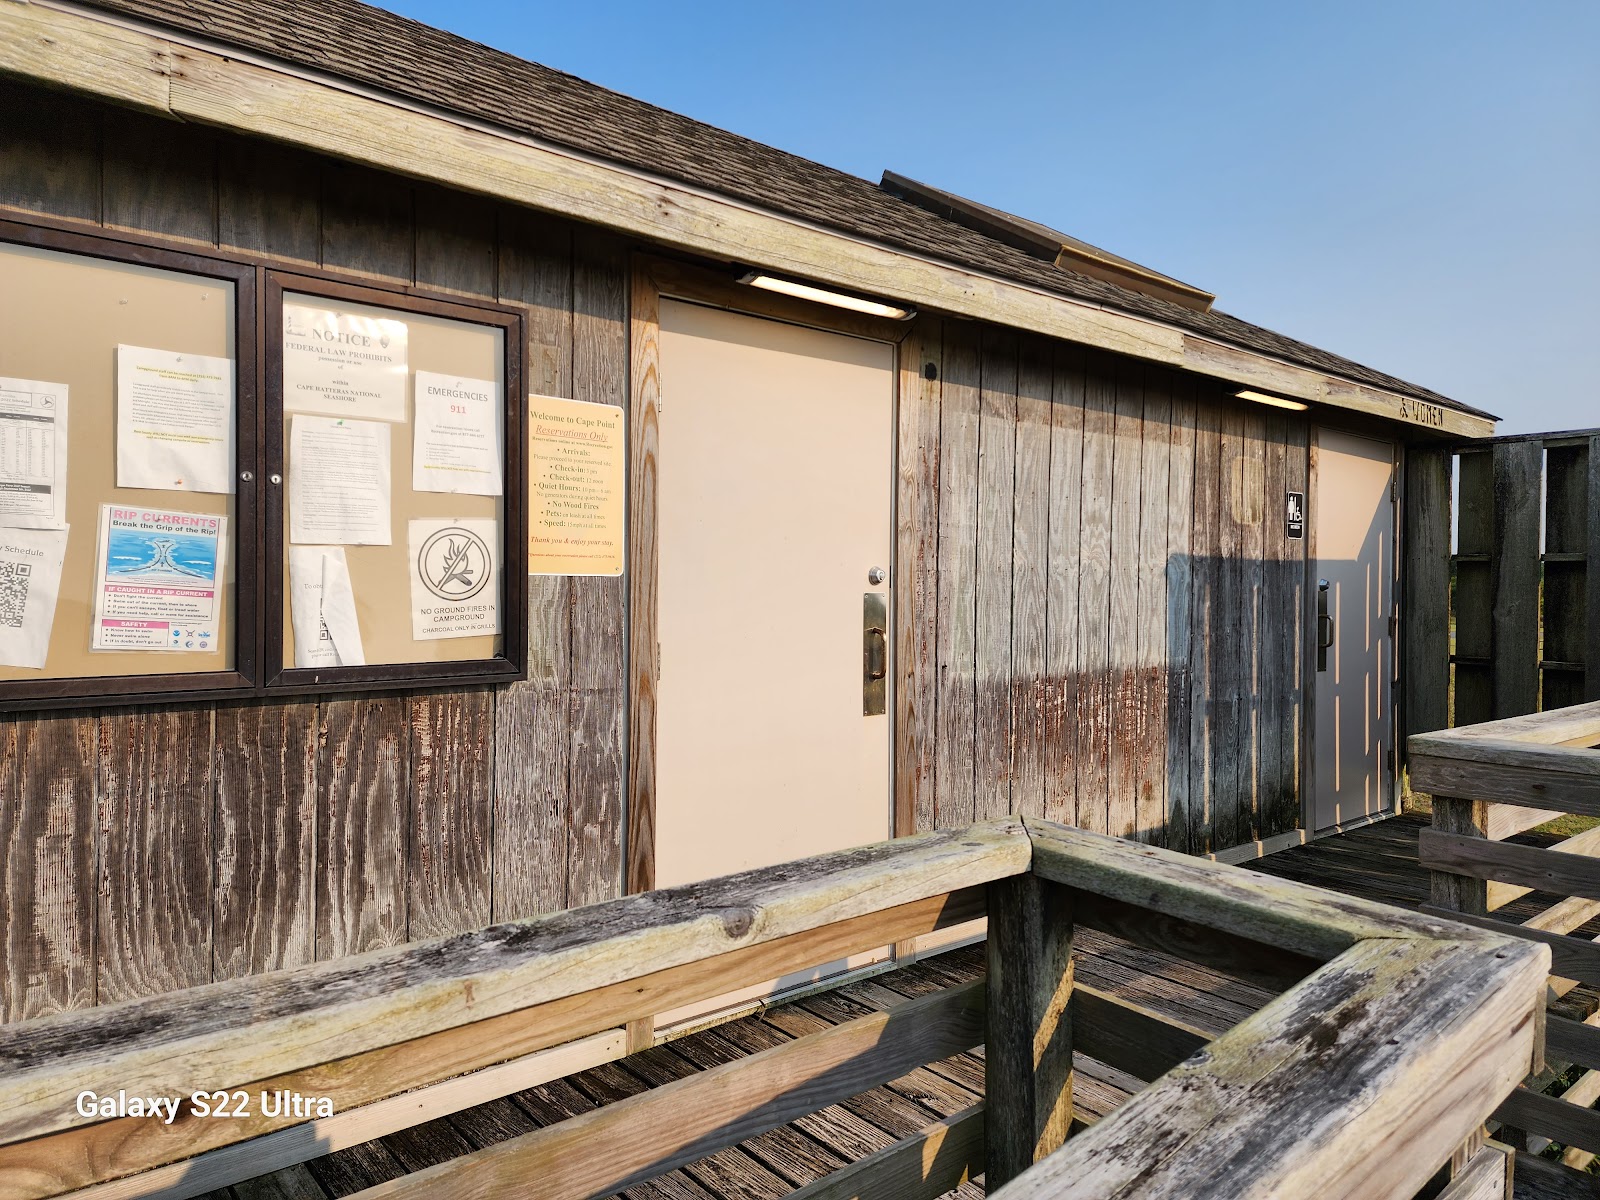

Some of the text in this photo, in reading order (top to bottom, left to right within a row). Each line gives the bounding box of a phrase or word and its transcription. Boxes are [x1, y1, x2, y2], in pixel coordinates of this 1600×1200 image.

[312, 328, 371, 347] NOTICE
[286, 342, 392, 362] FEDERAL LAW PROHIBITS
[315, 386, 349, 394] HATTERAS
[350, 390, 382, 398] NATIONAL
[428, 387, 488, 401] EMERGENCIES
[324, 394, 356, 402] SEASHORE
[451, 405, 466, 413] 911
[1413, 401, 1442, 426] WOMEN
[530, 411, 564, 422] Welcome
[576, 417, 594, 427] Cape
[597, 420, 614, 428] Point
[536, 425, 608, 442] Reservations Only
[562, 448, 590, 456] Arrivals:
[555, 464, 585, 473] Check-in:
[550, 473, 584, 483] Check-out:
[539, 482, 557, 490] Quiet
[114, 509, 216, 527] RIP CURRENTS
[113, 520, 137, 528] Break
[5, 546, 43, 556] Schedule
[434, 614, 484, 622] CAMPGROUND
